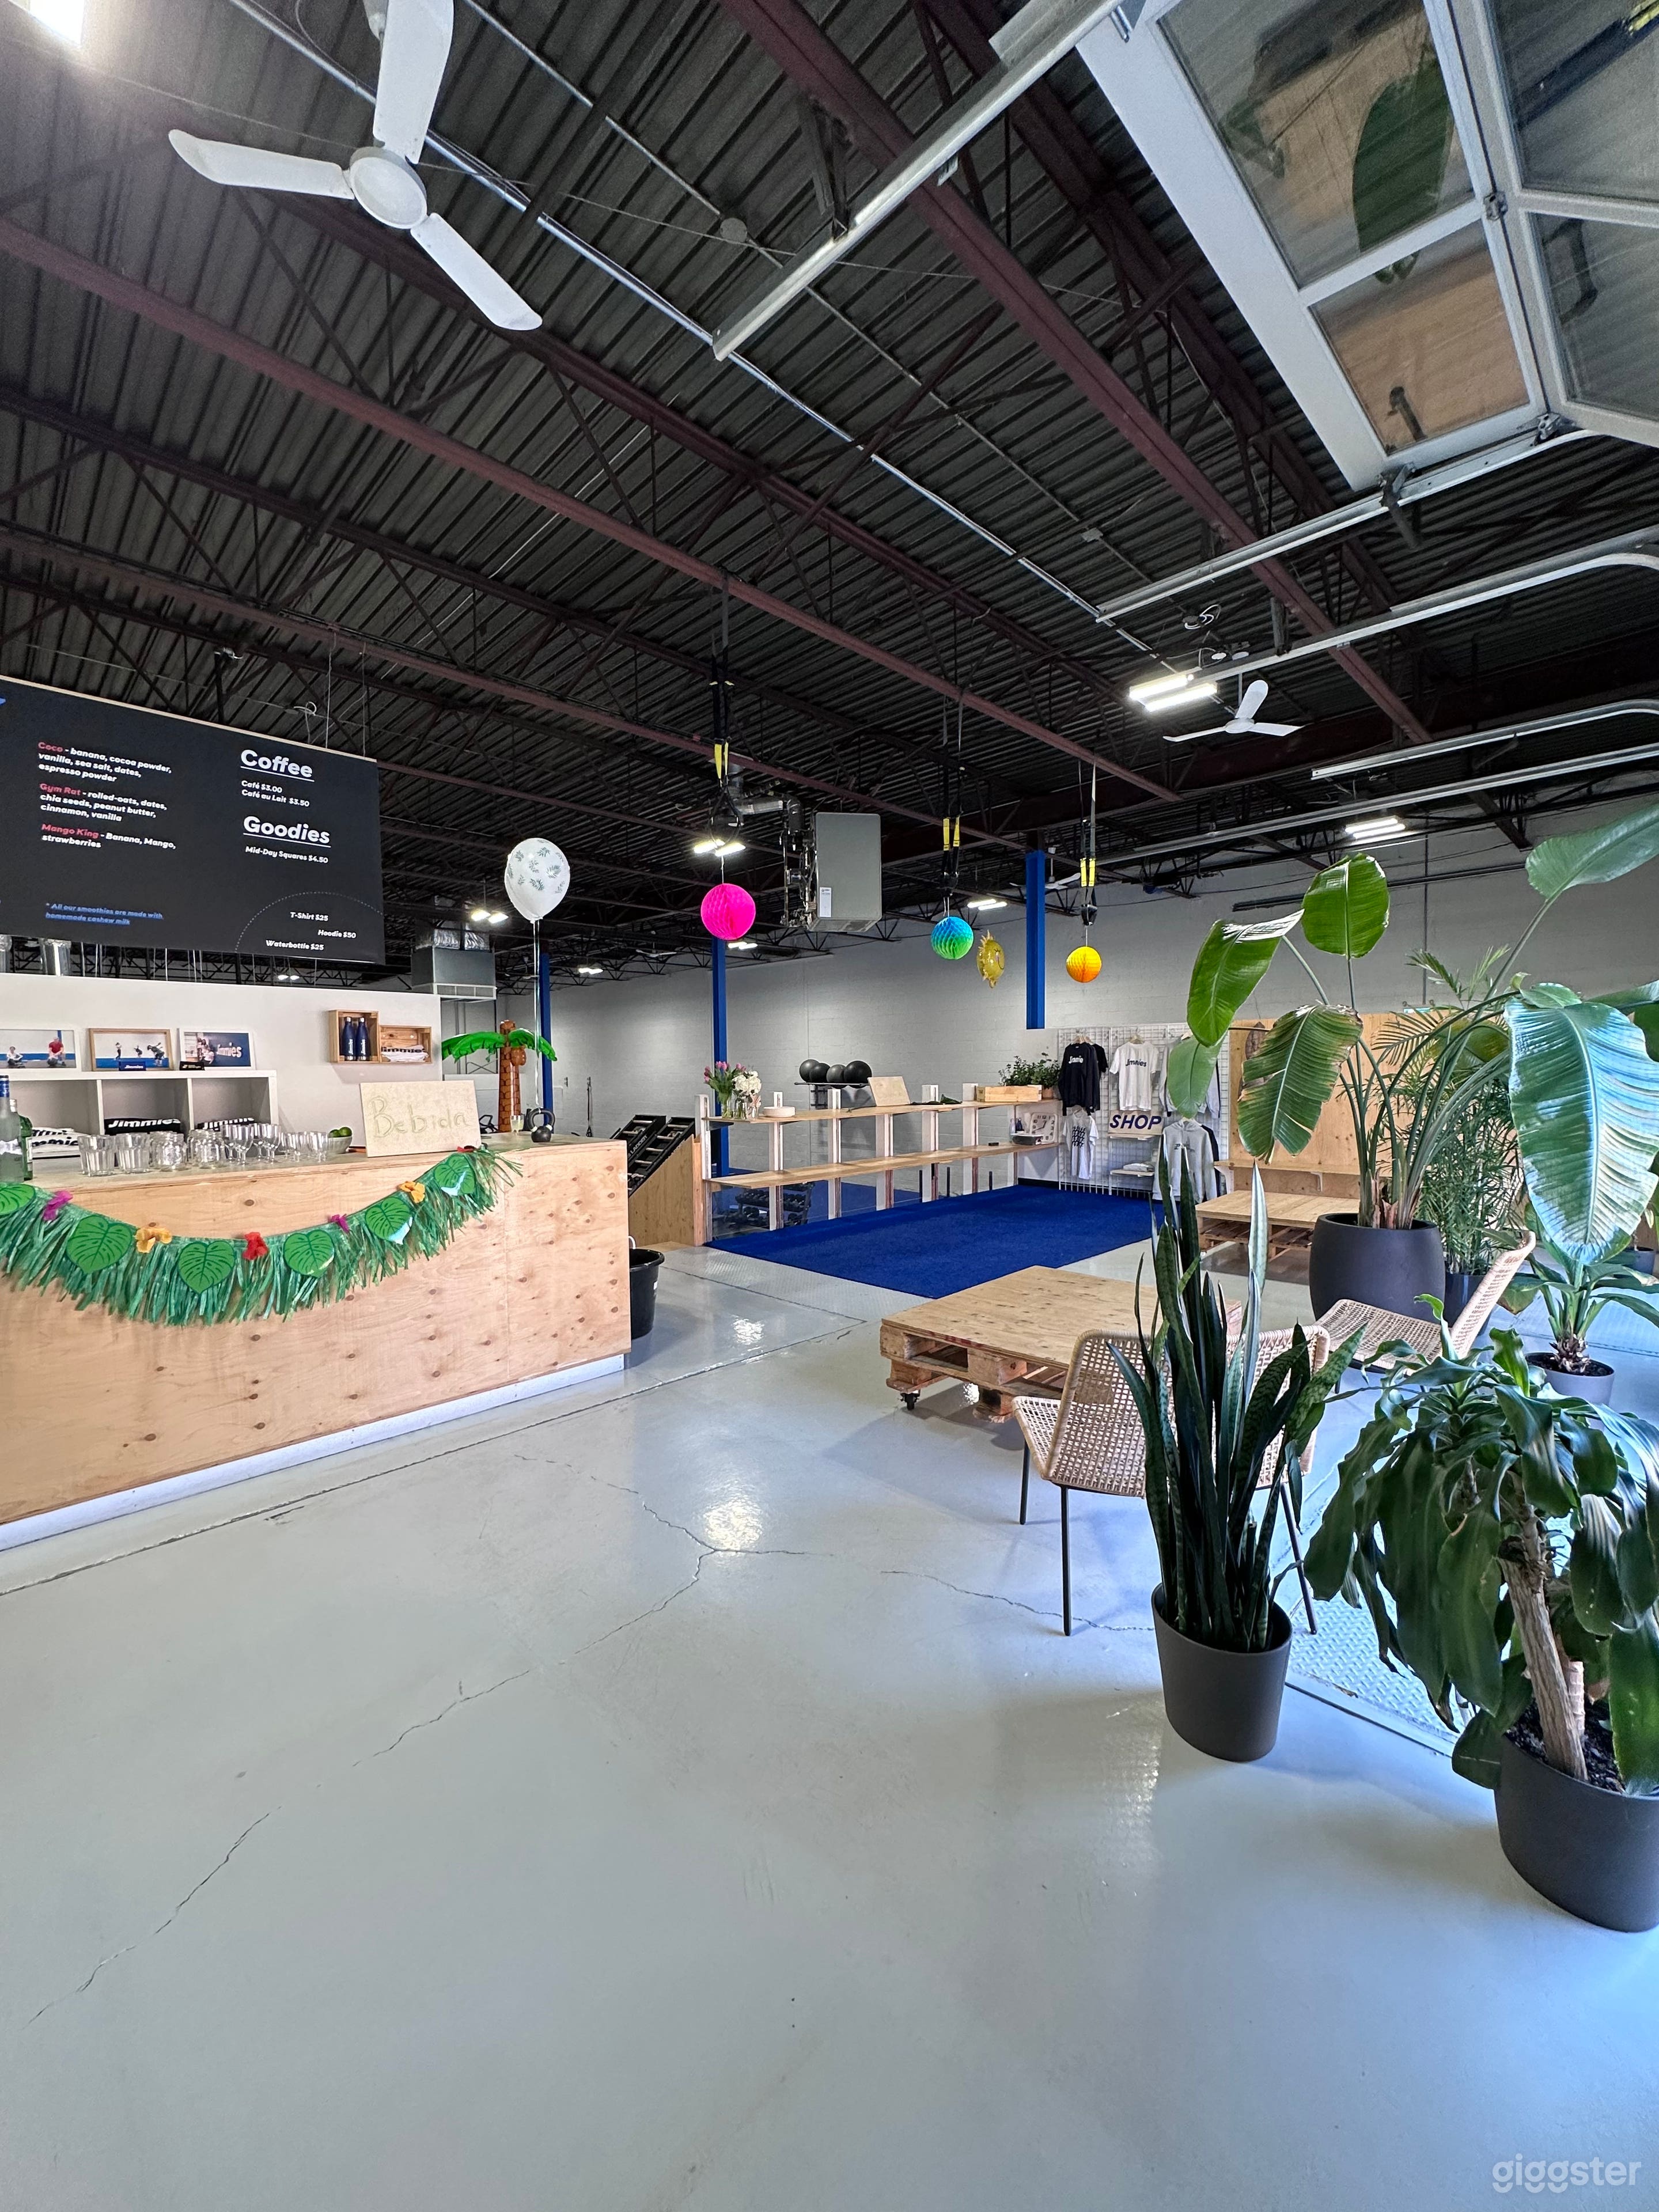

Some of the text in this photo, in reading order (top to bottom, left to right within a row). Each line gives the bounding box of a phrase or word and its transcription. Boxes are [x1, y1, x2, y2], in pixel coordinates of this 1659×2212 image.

[38, 742, 63, 752] Coco
[70, 748, 108, 762] banana,
[109, 756, 137, 766] cocoa
[137, 762, 172, 774] powder,
[39, 753, 142, 778] vanilla, sea salt, dates,
[241, 749, 313, 778] Coffee
[39, 763, 117, 782] espresso powder
[241, 780, 283, 793] Café $3.00
[40, 783, 62, 794] Gym
[64, 787, 81, 796] Rat
[88, 791, 139, 806] rolled-oats,
[141, 798, 168, 810] dates,
[40, 793, 157, 818] chia seeds, peanut butter,
[241, 789, 260, 798] Café
[272, 794, 287, 803] Lait
[289, 798, 310, 807] $3.50
[40, 804, 122, 822] cinnamon, vanilla
[41, 823, 75, 835] Mango
[77, 828, 100, 839] King
[106, 832, 143, 845] Banana,
[144, 837, 176, 850] Mango,
[244, 816, 330, 844] Goodies
[41, 834, 102, 848] strawberries
[245, 846, 329, 863] Mid-Day Squares $4.50
[290, 912, 329, 922] T-Shirt $25
[318, 930, 342, 938] Hoodie
[266, 940, 310, 950] Waterbottle
[368, 1096, 470, 1138] Bebida
[1110, 1115, 1161, 1130] SHOP
